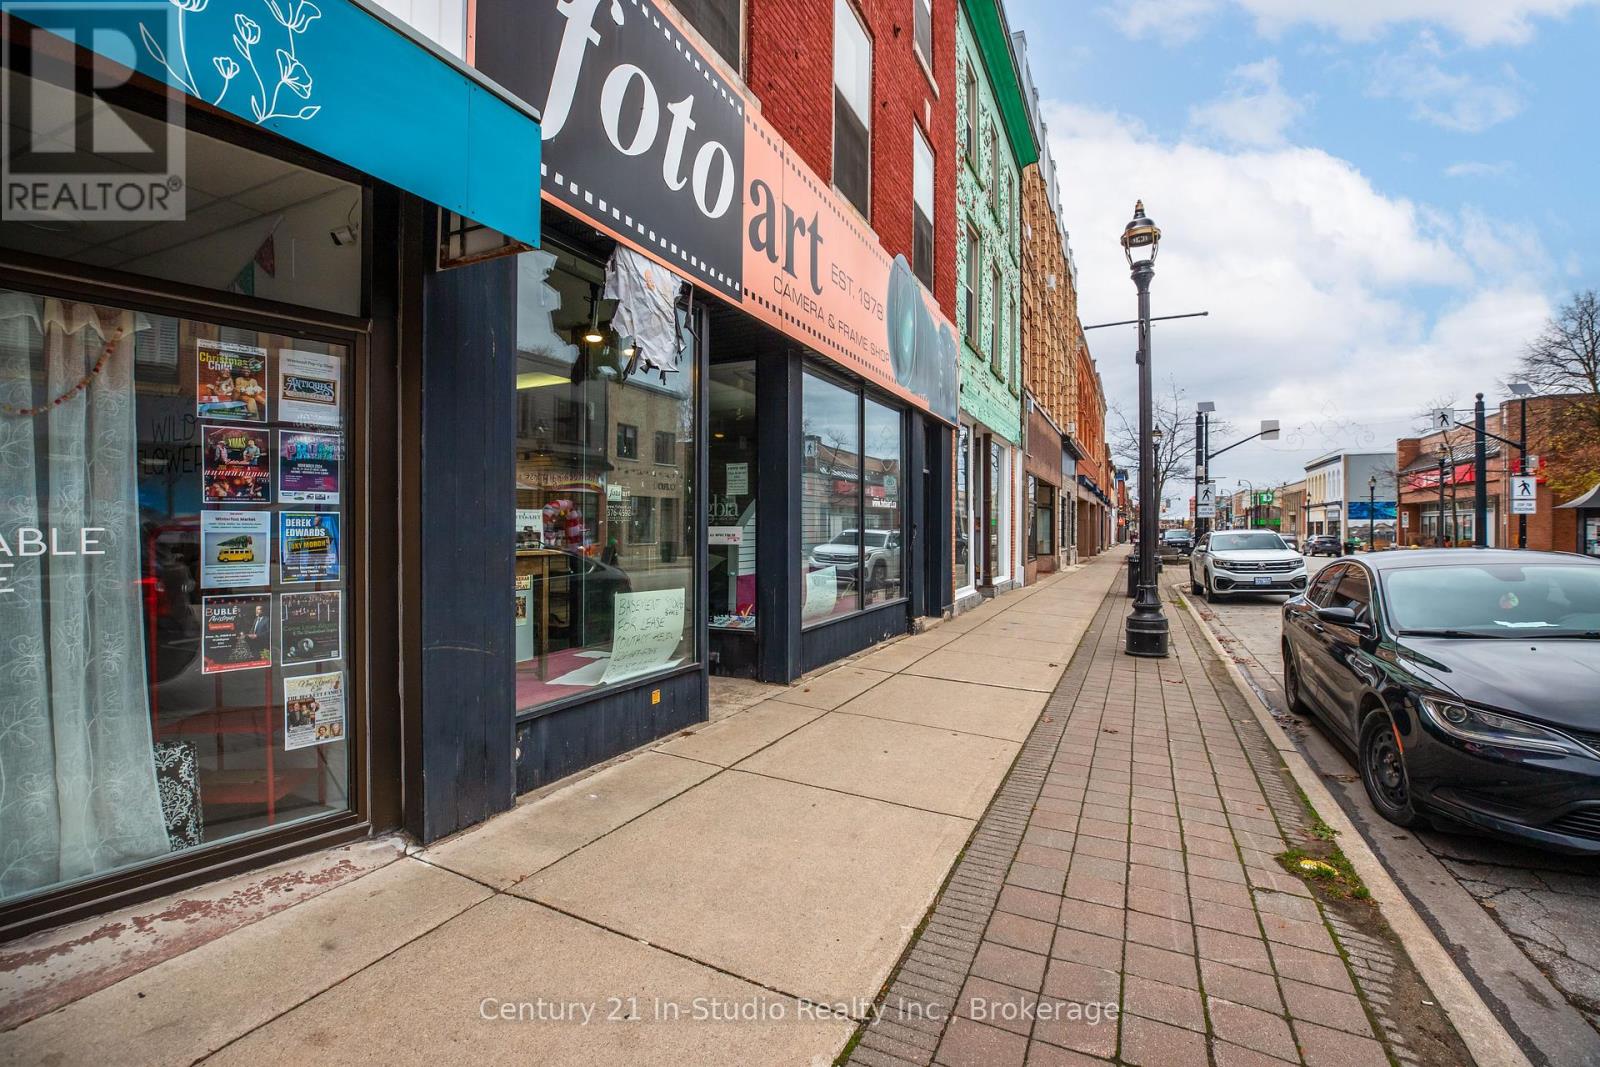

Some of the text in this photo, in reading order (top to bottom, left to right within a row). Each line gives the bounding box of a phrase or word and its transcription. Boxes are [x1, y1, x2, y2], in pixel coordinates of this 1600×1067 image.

[541, 0, 735, 219] foto
[748, 179, 824, 295] art
[773, 275, 825, 322] CAMERA
[828, 313, 835, 330] &
[838, 320, 868, 351] FRAME
[200, 351, 248, 367] Christmas
[286, 518, 312, 527] DEREK
[286, 528, 326, 537] EDWARDS
